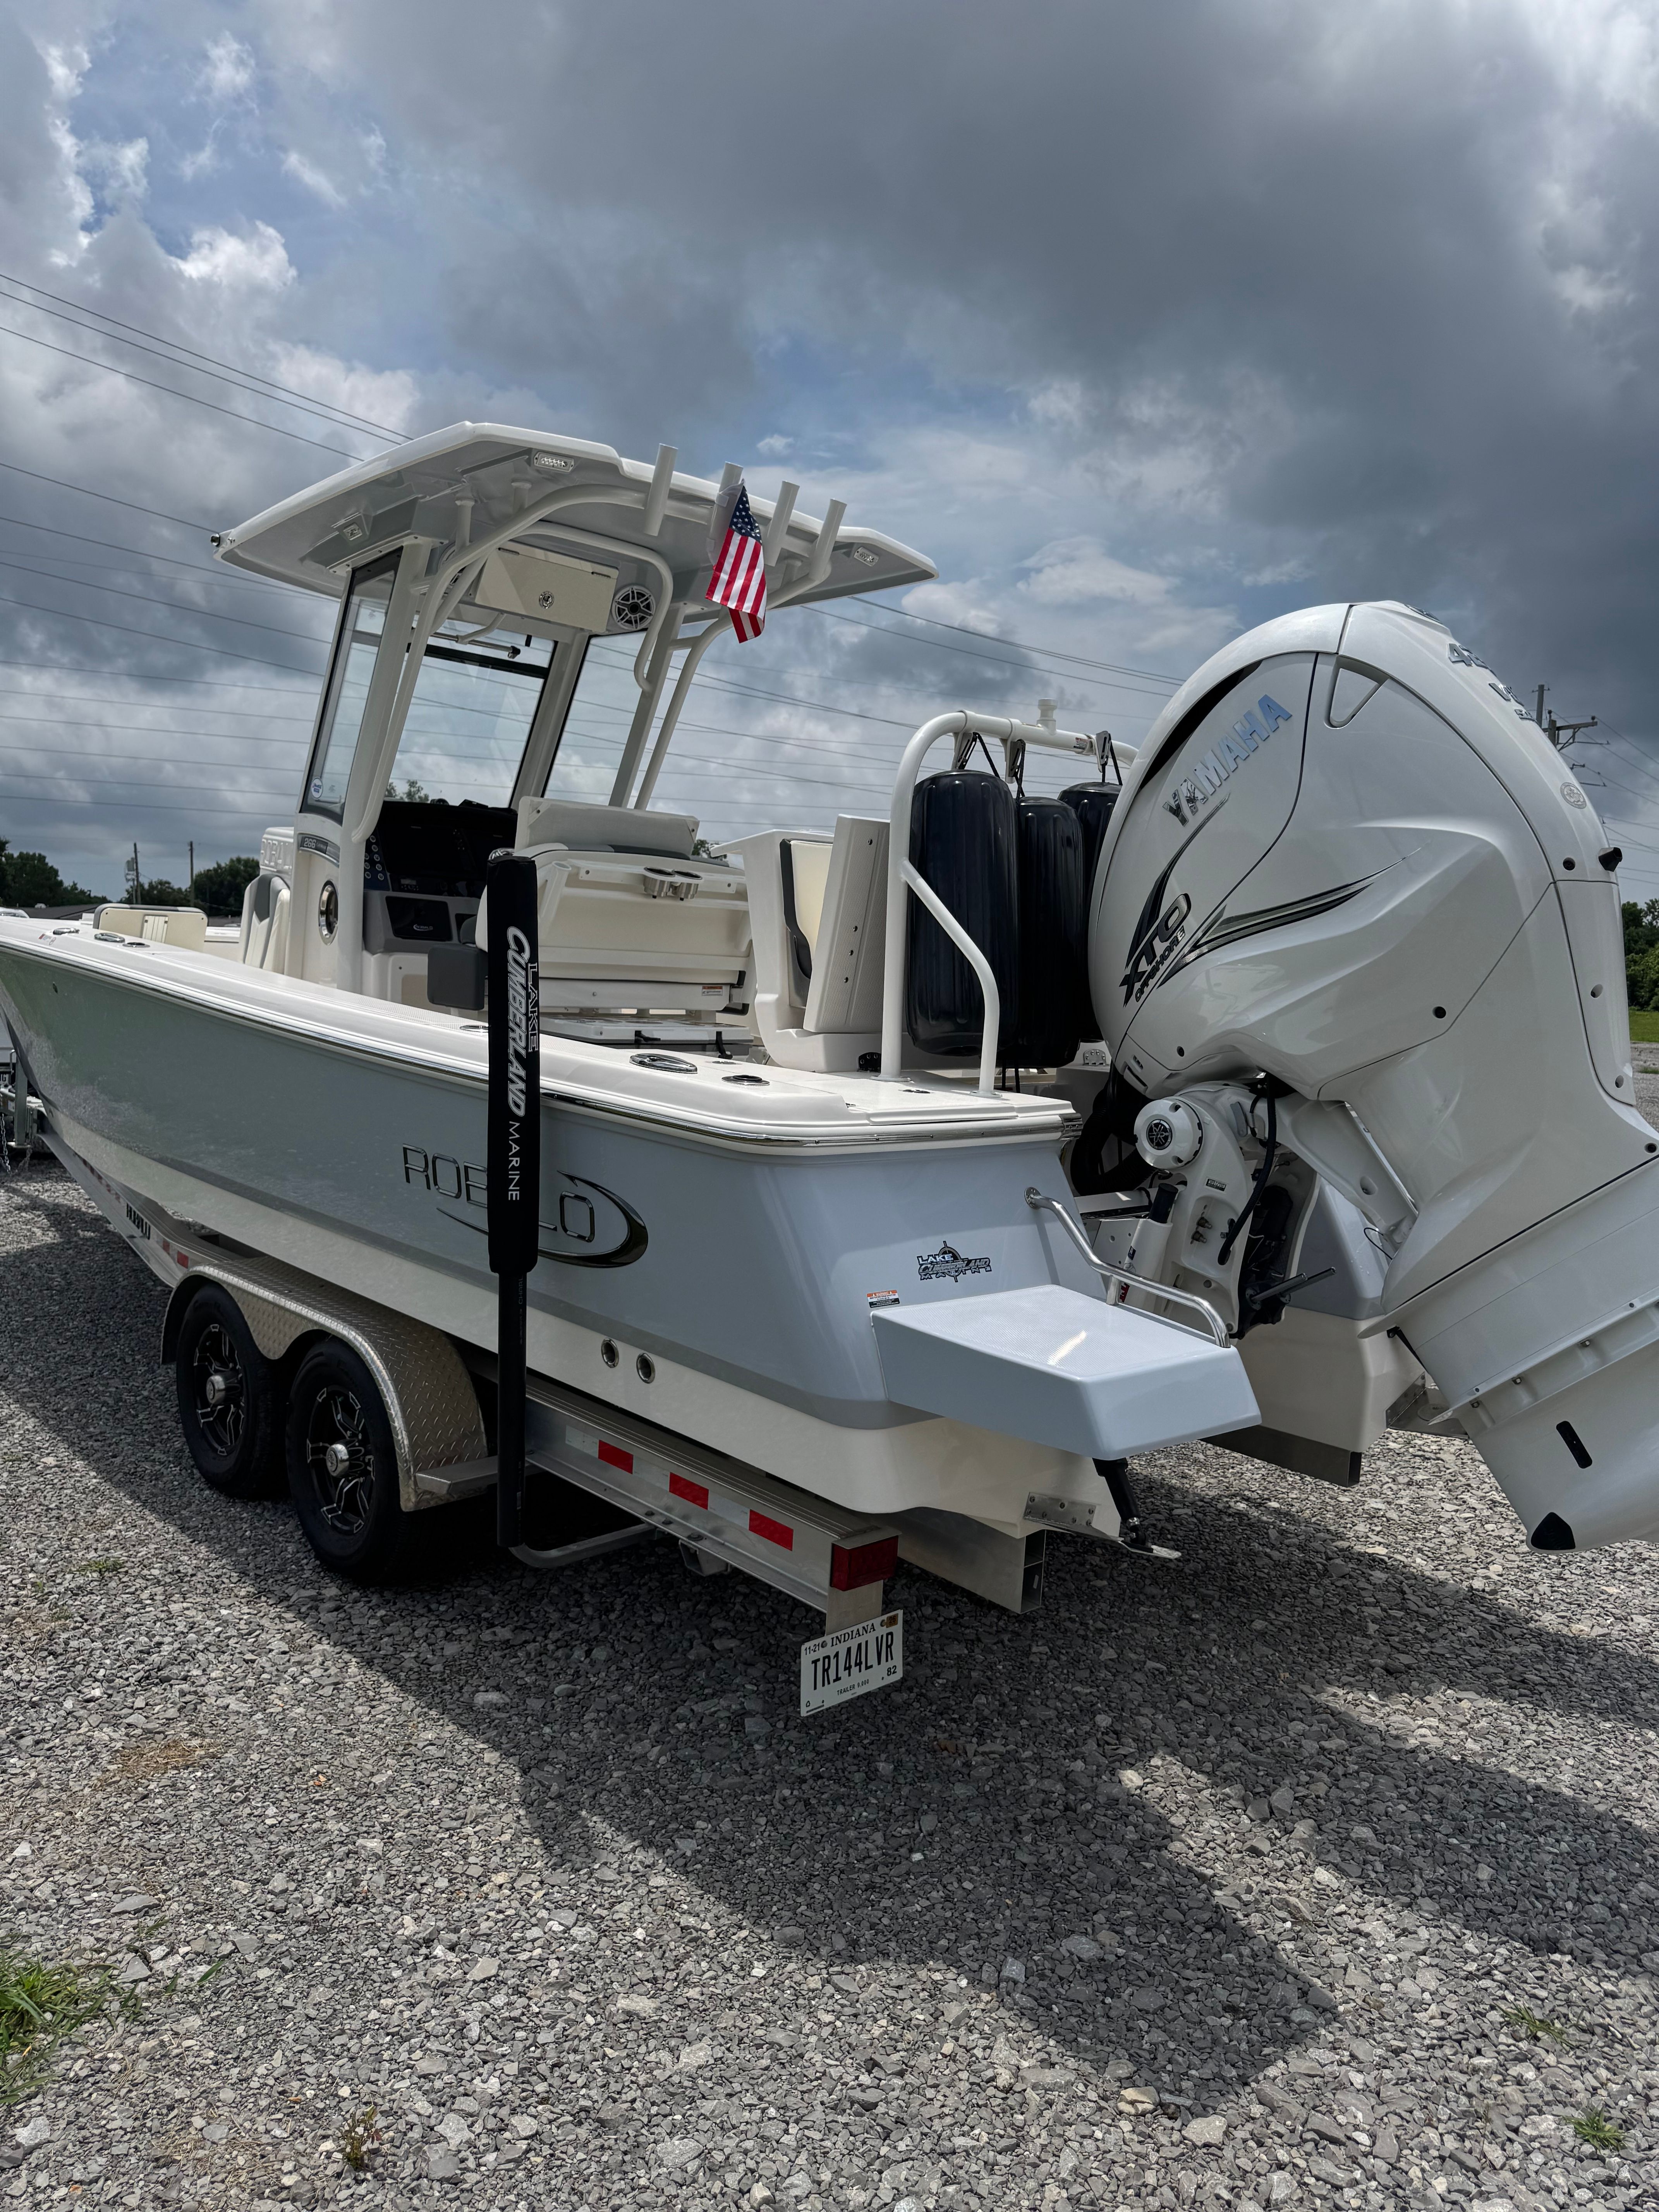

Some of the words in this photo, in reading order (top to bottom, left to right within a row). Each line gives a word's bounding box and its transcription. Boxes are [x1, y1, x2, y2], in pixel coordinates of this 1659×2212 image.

[1162, 694, 1292, 826] YAMAHA
[303, 837, 316, 849] 266
[1119, 893, 1192, 1008] XTO
[1135, 925, 1185, 1002] OFFSHORE
[507, 926, 531, 1117] CUMBERLAND
[527, 962, 538, 1053] LAKE
[403, 1143, 595, 1243] ROBO
[508, 1121, 521, 1201] MARINE
[917, 1253, 954, 1265] LAKE
[804, 1642, 820, 1656] 11-21
[830, 1623, 876, 1647] INDIANA
[811, 1631, 894, 1690] TR144LVR
[887, 1665, 897, 1676] 82
[837, 1684, 855, 1696] TRAILER
[857, 1679, 869, 1688] 9,000
